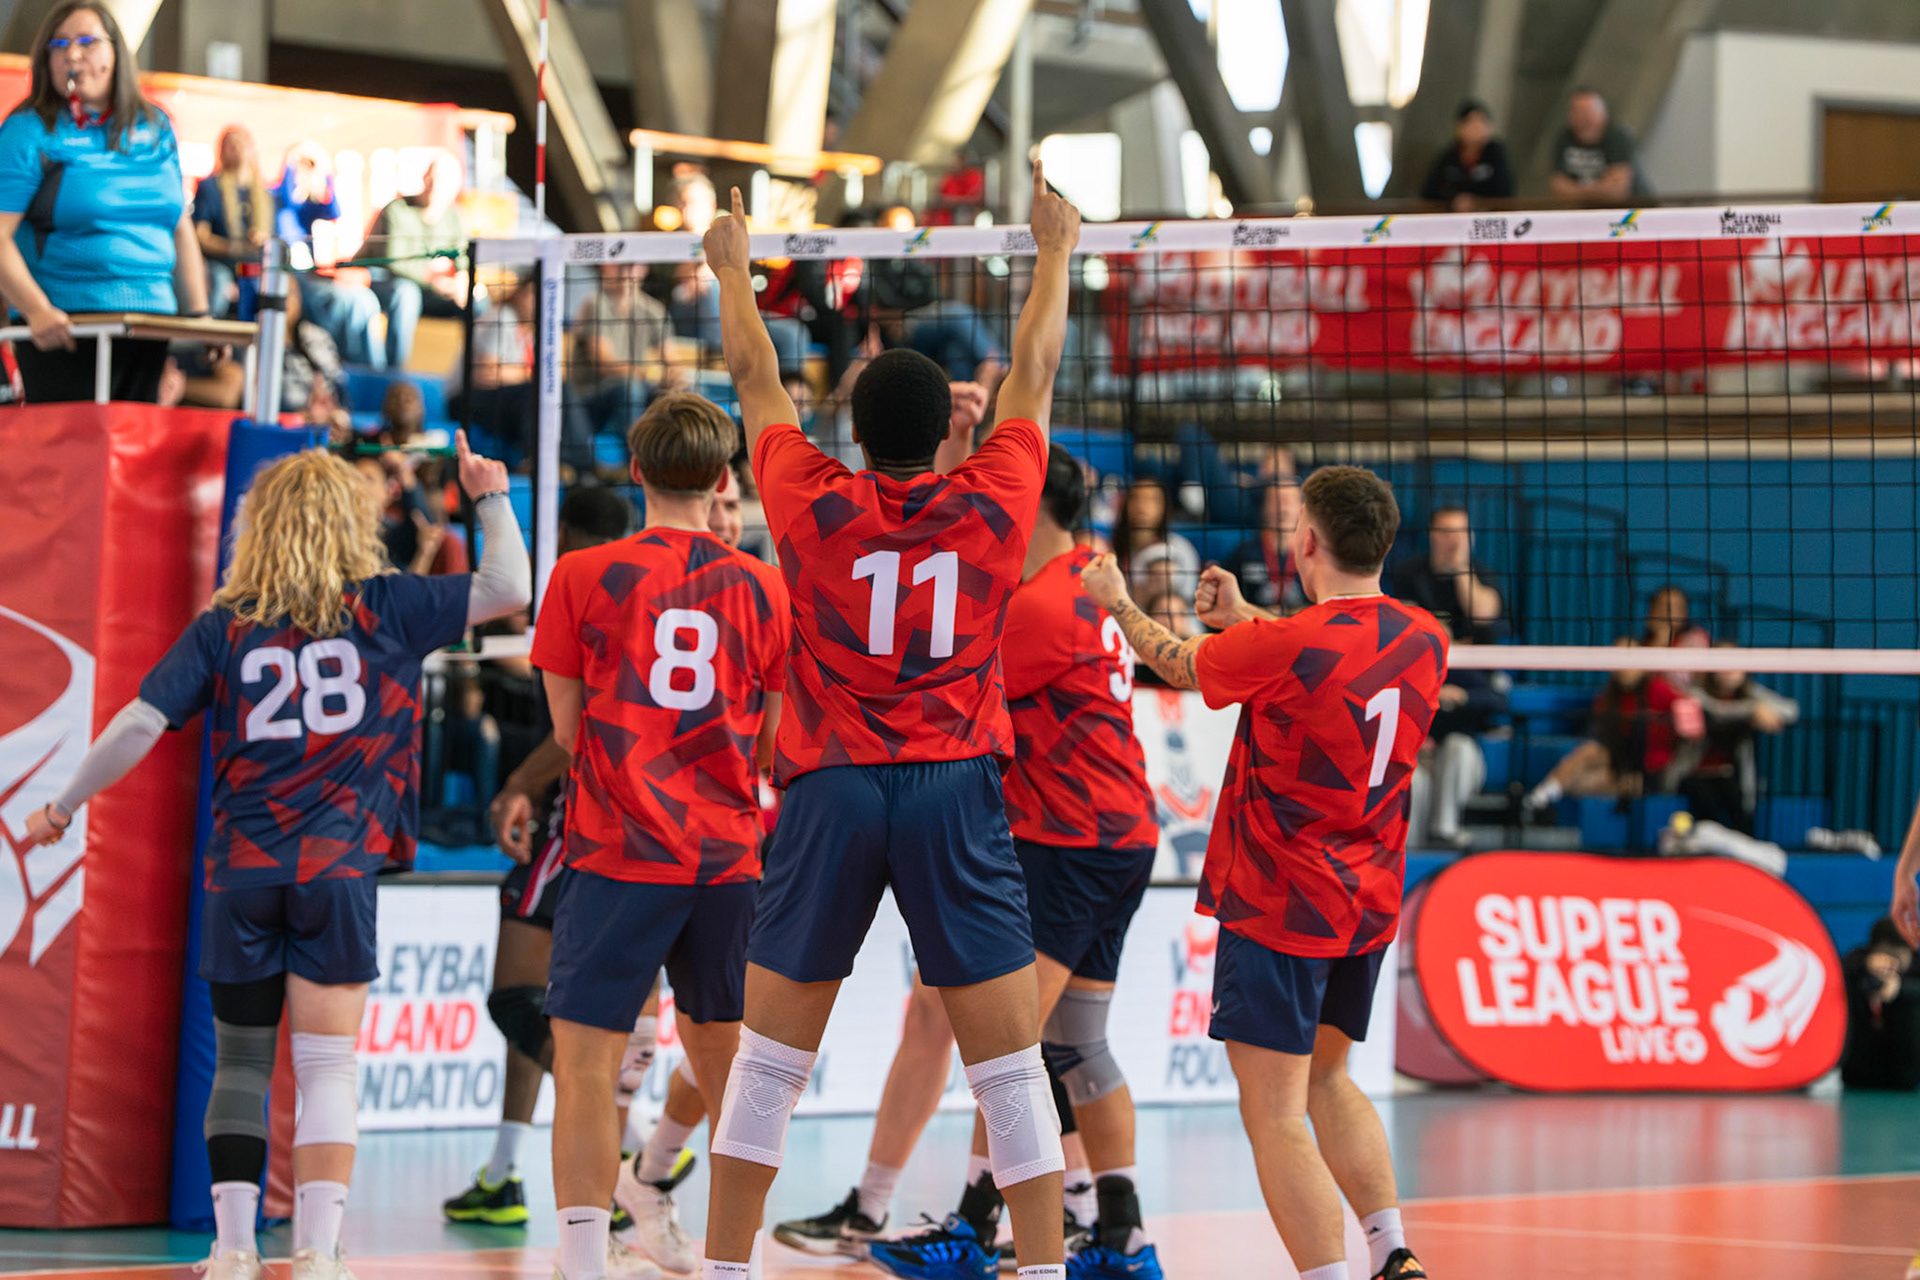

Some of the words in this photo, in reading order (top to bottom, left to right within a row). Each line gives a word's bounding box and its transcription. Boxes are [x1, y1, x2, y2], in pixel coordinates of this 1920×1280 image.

[852, 550, 959, 659] 11
[240, 637, 366, 741] 28
[649, 608, 719, 711] 8
[1364, 687, 1400, 787] 1
[1475, 893, 1686, 962] SUPER
[1456, 957, 1699, 1027] LEAGUE
[1601, 1026, 1676, 1064] LIVE
